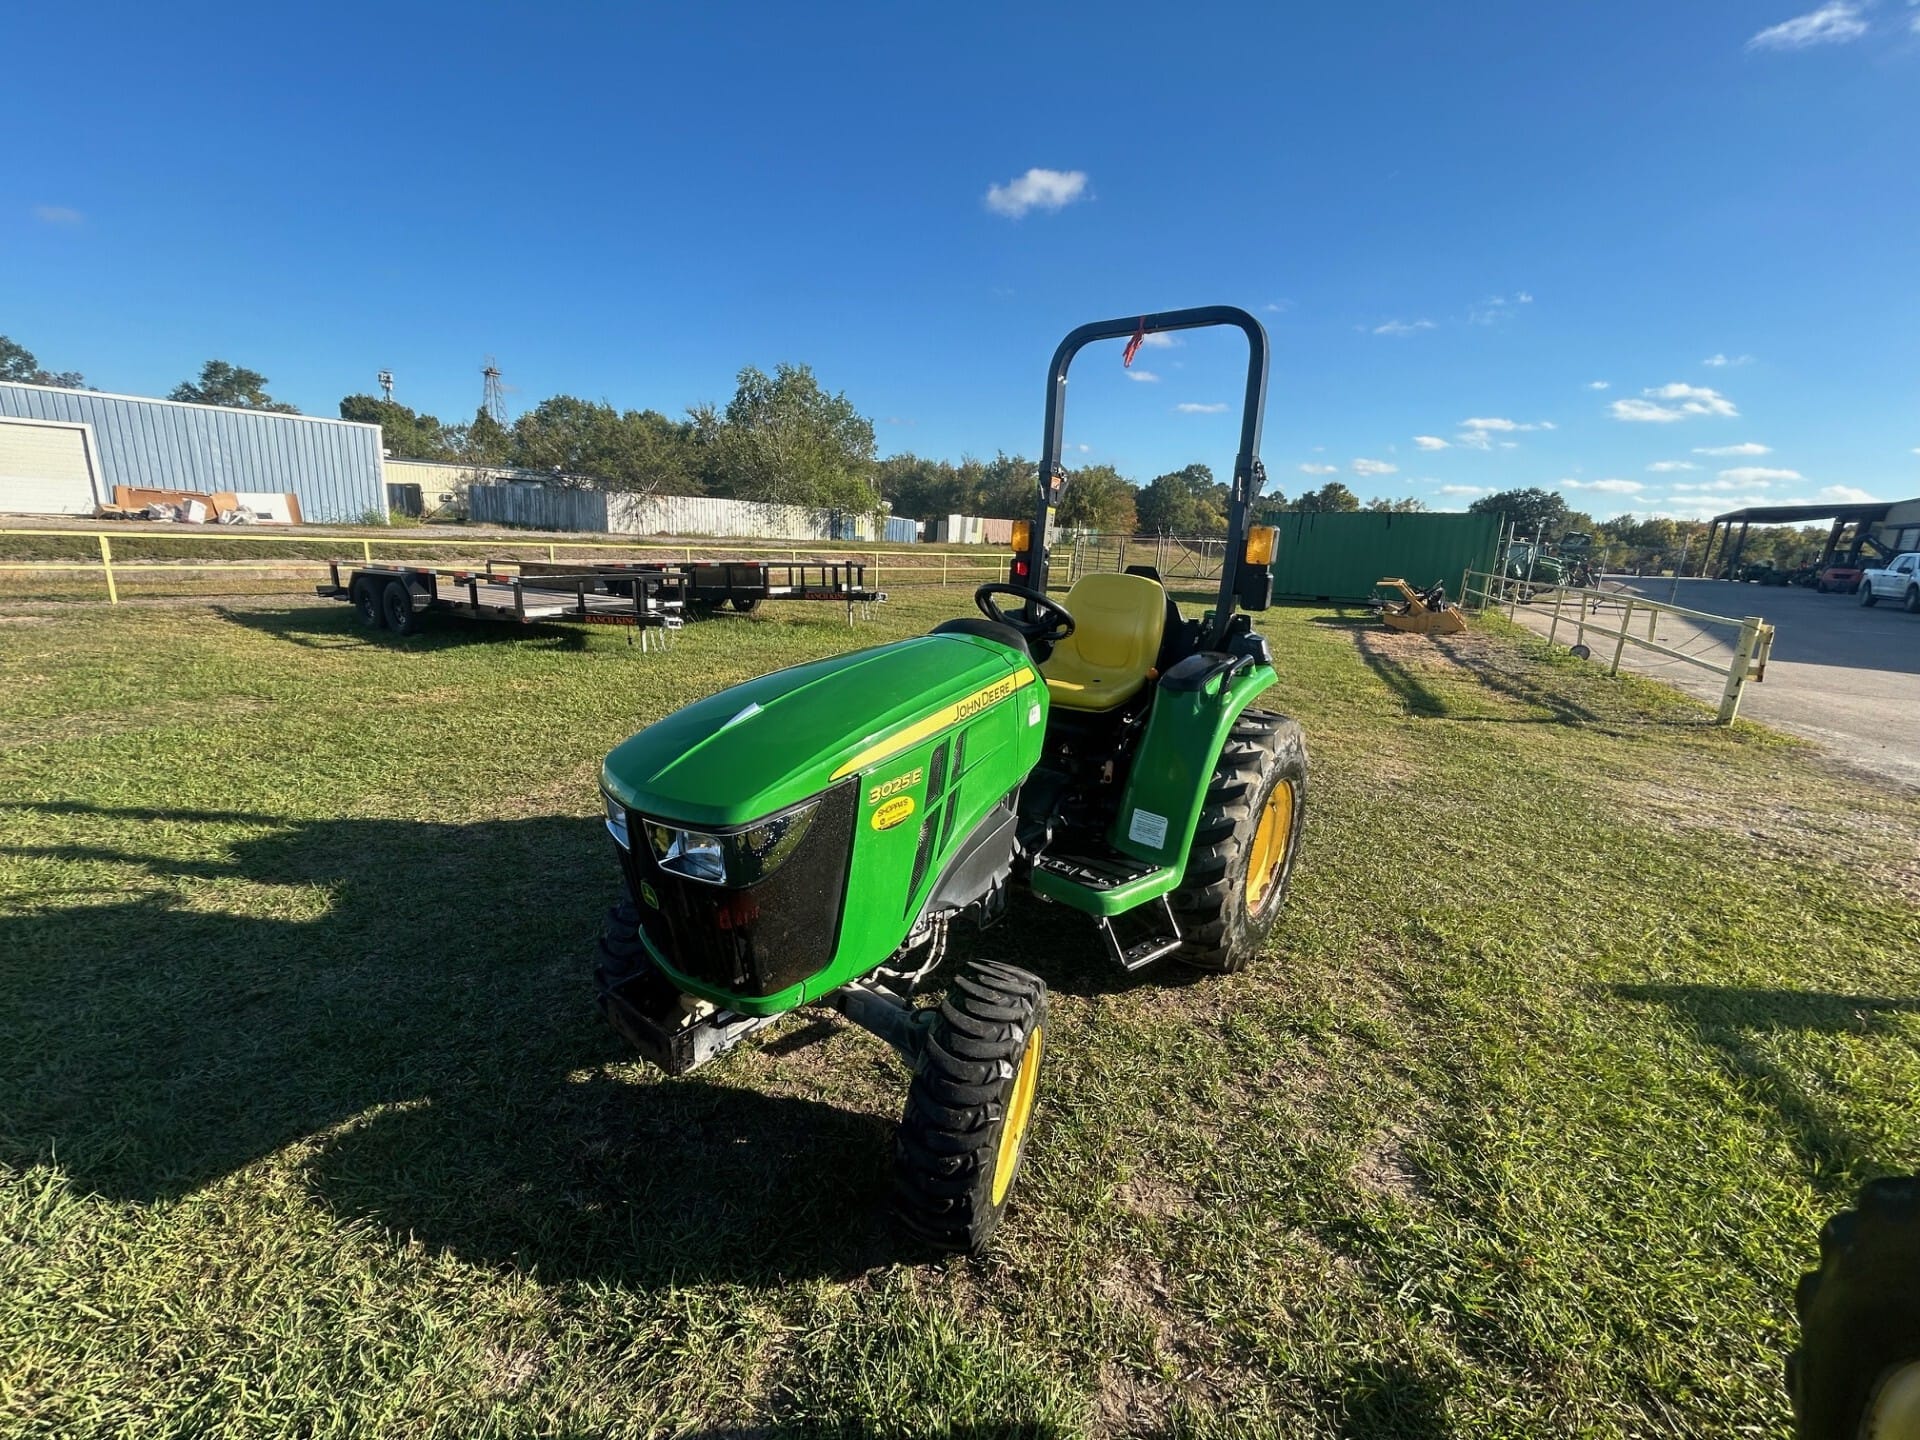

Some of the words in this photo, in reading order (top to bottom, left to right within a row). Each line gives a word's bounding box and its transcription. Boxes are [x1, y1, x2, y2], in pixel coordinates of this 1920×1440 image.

[585, 615, 614, 624] RANCH
[615, 616, 637, 625] KING
[953, 697, 981, 722] JOHN
[981, 682, 1010, 706] DEERE
[868, 768, 923, 805] 3025E
